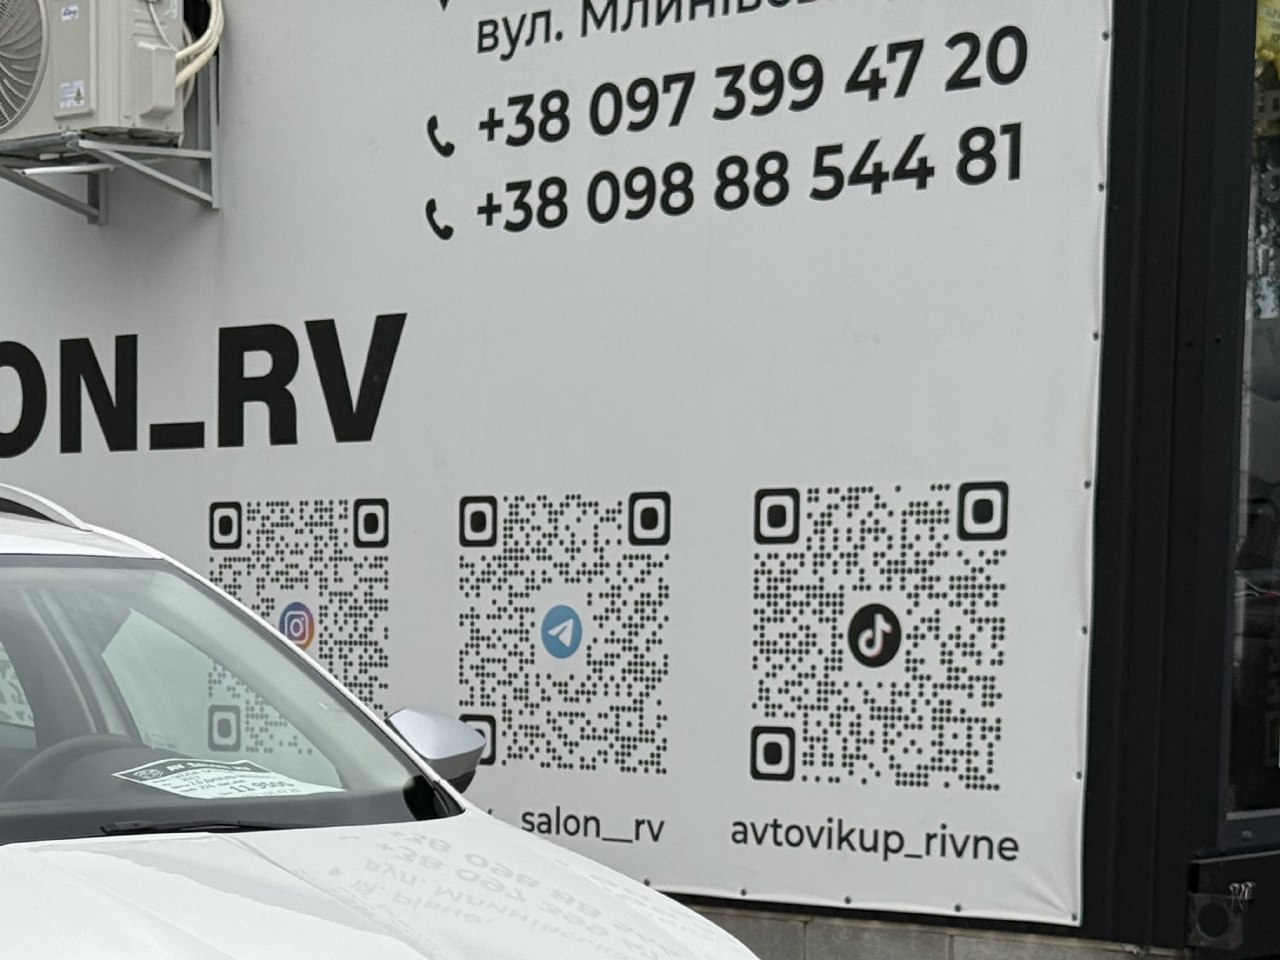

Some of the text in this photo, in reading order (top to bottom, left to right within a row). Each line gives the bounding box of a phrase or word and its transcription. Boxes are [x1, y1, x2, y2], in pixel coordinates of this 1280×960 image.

[477, 9, 563, 62] вул.
[478, 25, 1028, 148] +38 097 399 47 20
[477, 122, 1022, 233] +38 098 88 544 81
[731, 817, 1019, 862] avtovikup_rivne
